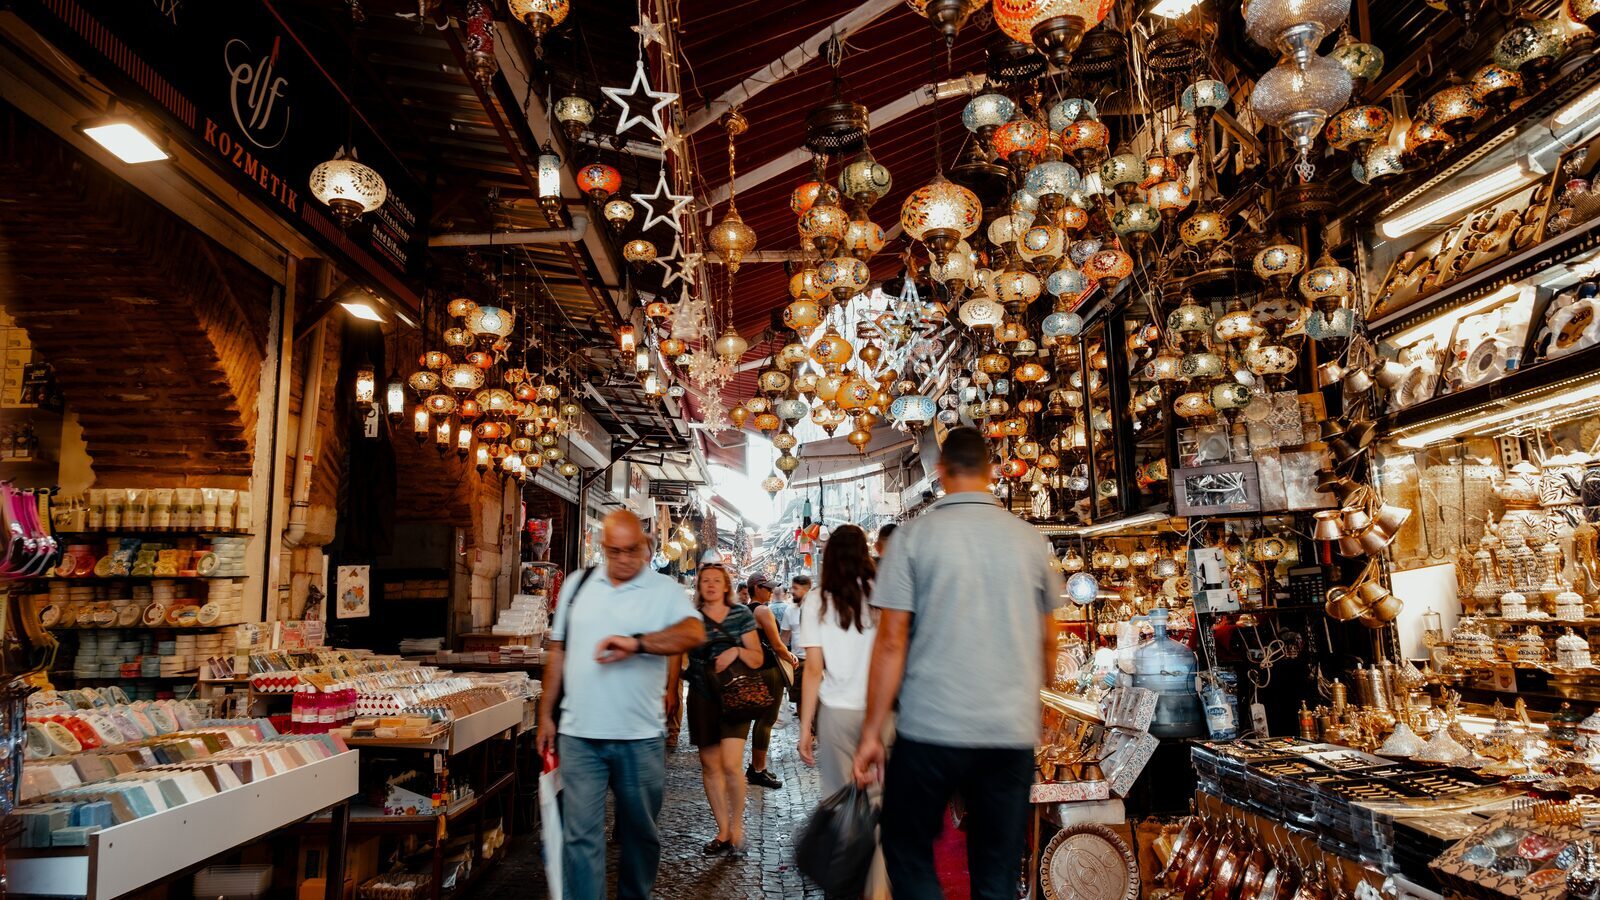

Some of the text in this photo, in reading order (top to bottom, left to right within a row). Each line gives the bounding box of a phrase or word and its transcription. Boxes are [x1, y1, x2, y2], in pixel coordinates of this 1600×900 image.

[205, 117, 298, 212] KOZMETİK
[372, 223, 387, 242] Reed
[387, 237, 407, 262] Diffuser
[384, 209, 410, 241] Freshener
